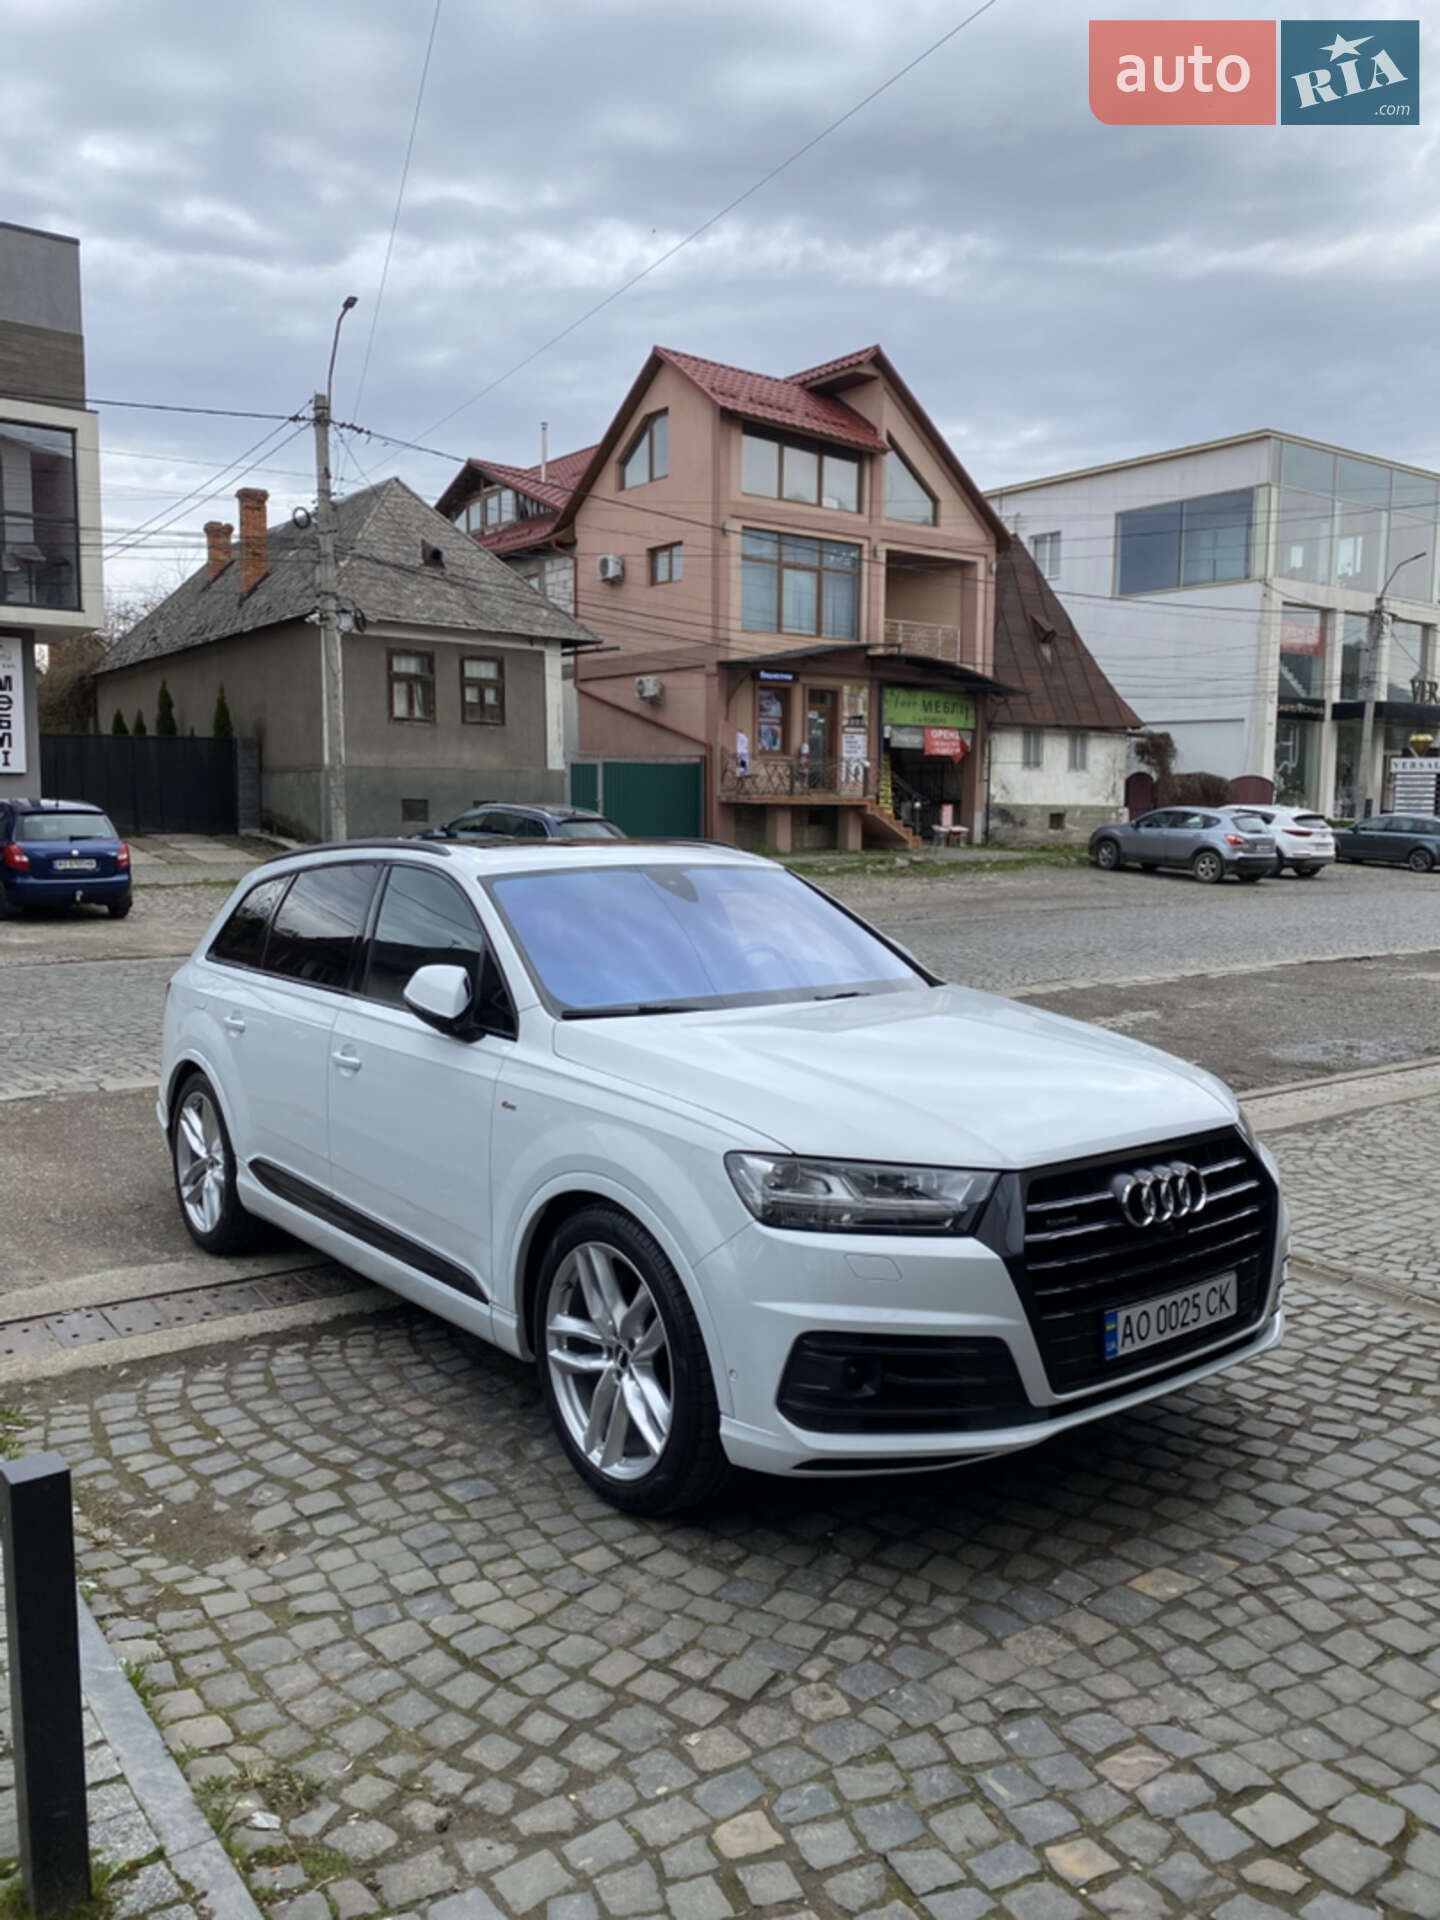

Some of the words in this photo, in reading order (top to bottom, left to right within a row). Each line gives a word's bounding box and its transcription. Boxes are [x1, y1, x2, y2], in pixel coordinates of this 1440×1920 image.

[1121, 1311, 1150, 1347] AO
[1156, 1292, 1201, 1335] 0025
[1206, 1281, 1232, 1316] CK
